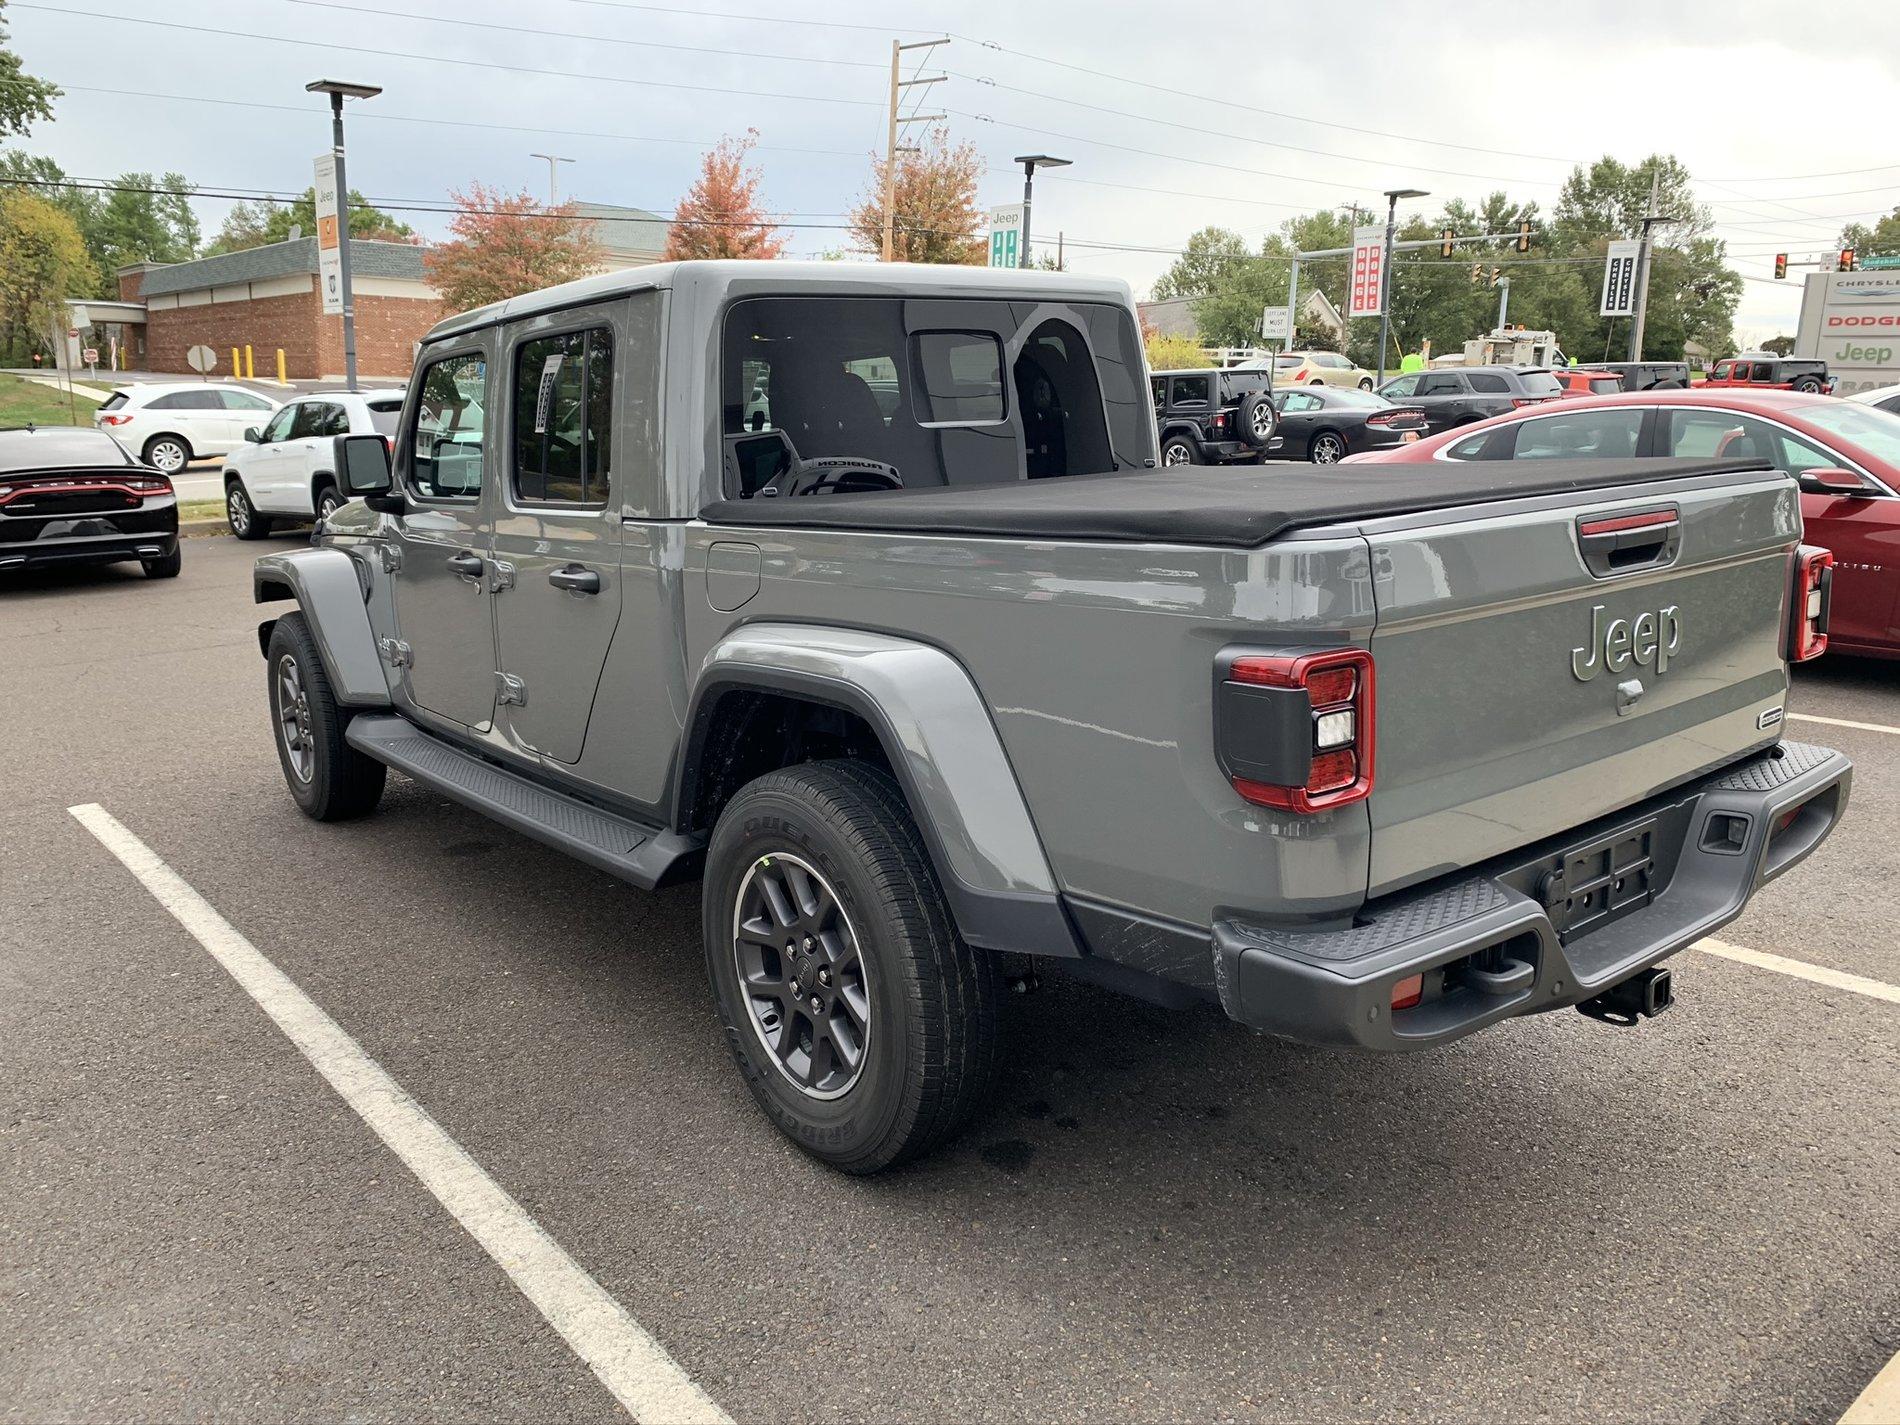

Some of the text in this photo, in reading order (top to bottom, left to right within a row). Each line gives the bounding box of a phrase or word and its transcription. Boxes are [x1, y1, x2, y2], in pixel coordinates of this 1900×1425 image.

[993, 213, 1018, 224] Jeep
[1355, 249, 1366, 308] DODGE
[1369, 248, 1379, 307] DODGE
[1608, 260, 1619, 308] CHRYSLER
[1620, 260, 1631, 308] CHRYSLER
[1835, 342, 1893, 365] Jeep
[1572, 605, 1681, 681] Jeep
